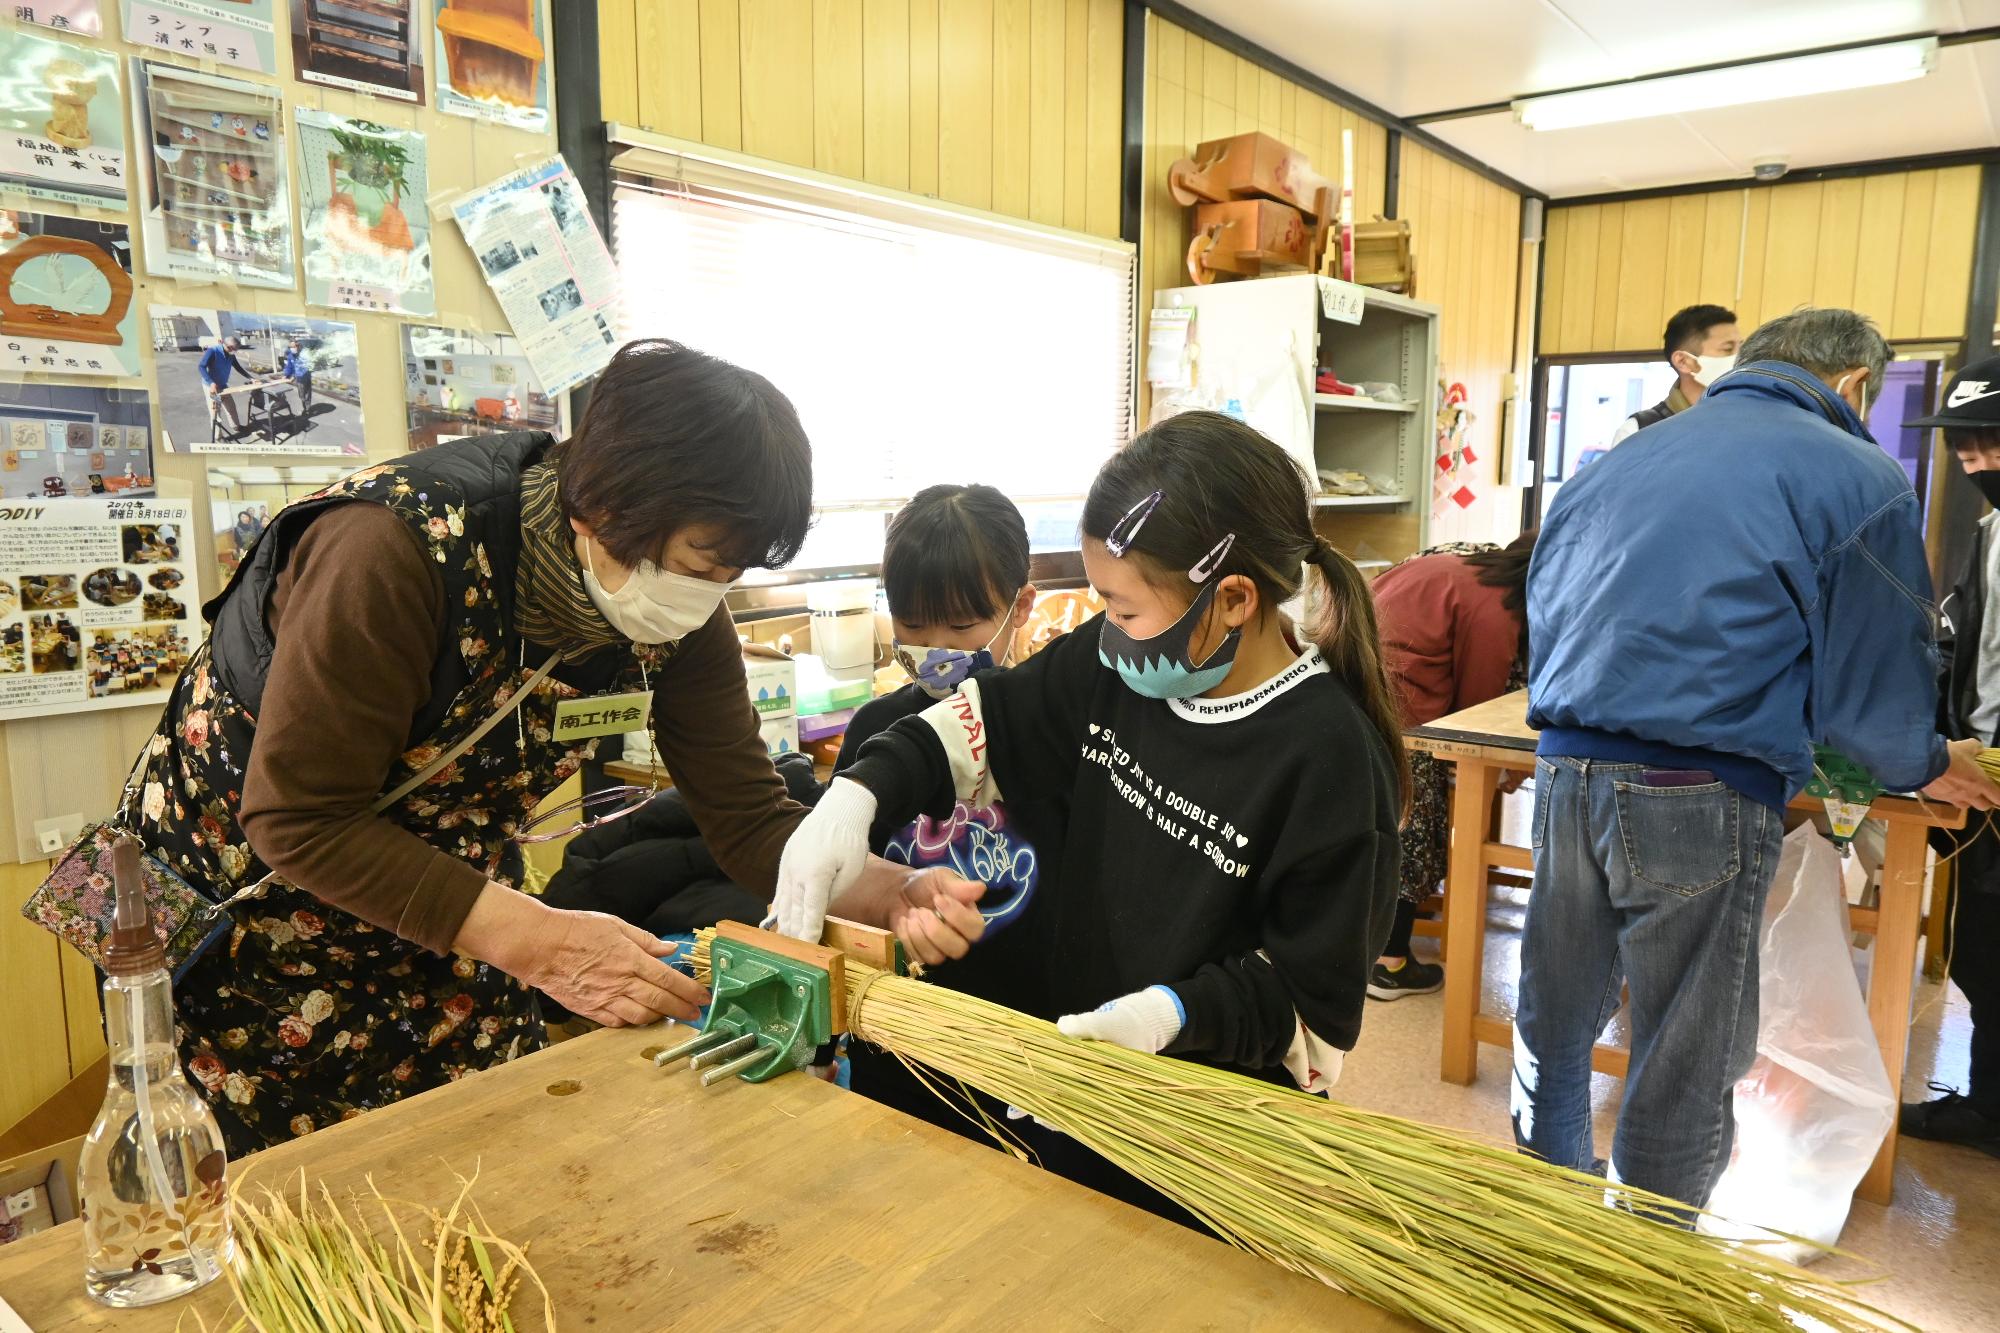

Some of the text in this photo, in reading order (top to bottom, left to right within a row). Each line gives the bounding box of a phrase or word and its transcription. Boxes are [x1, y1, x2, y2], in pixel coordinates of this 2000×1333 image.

[1957, 380, 1991, 397] NIKE
[107, 501, 146, 509] 2019年
[559, 706, 641, 730] 南工作会
[1154, 785, 1163, 800] A
[1165, 791, 1219, 830] DOUBLE
[1156, 812, 1188, 840] HALF
[1188, 834, 1200, 850] A
